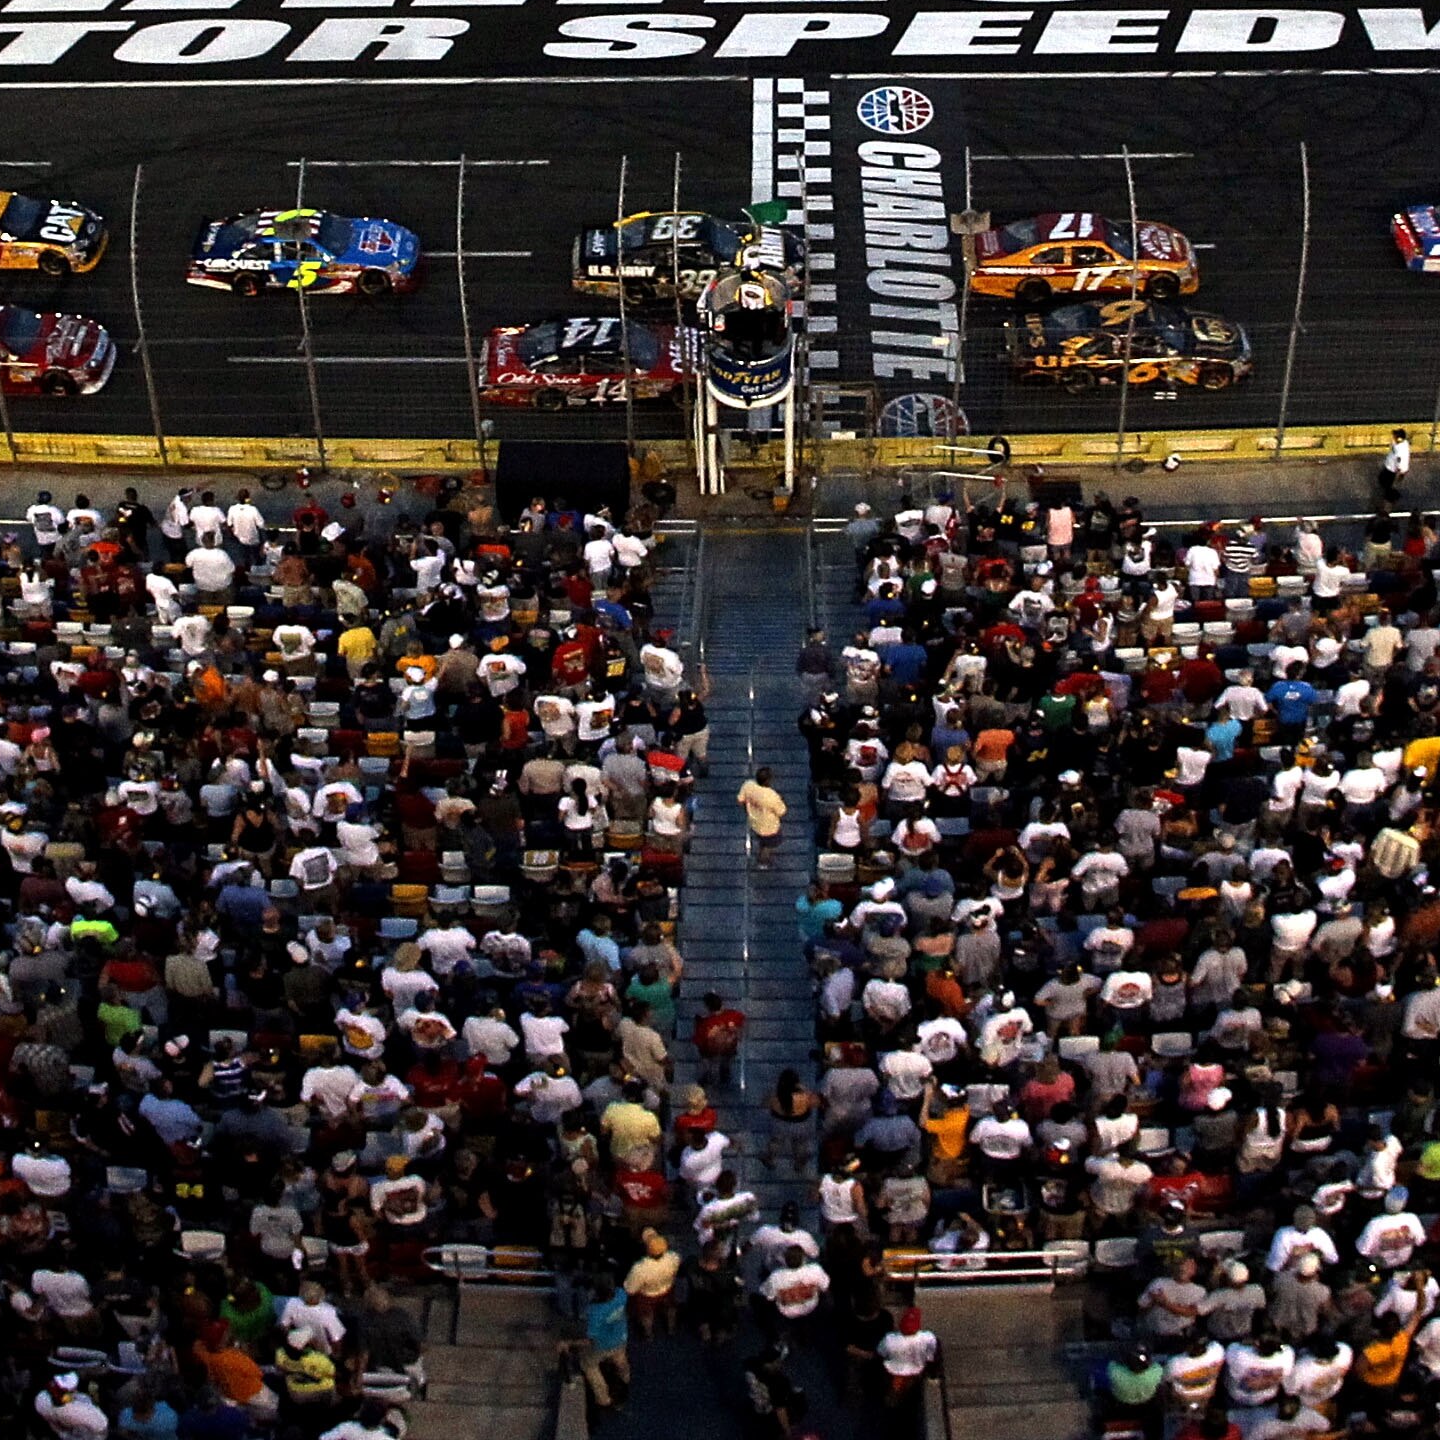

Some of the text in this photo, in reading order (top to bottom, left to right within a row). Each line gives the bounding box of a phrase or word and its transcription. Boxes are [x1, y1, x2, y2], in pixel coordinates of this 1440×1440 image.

[40, 205, 85, 244] CAT
[1049, 212, 1094, 240] 17
[203, 258, 272, 271] CARQUEST
[588, 265, 614, 277] U.S.
[857, 139, 966, 385] CHARLOTTE
[286, 261, 323, 288] 5
[679, 269, 718, 293] 39
[1073, 267, 1111, 291] 17
[1100, 299, 1148, 326] 6
[562, 317, 621, 348] 14
[497, 371, 582, 384] Old Spice
[740, 384, 760, 393] Get
[589, 378, 629, 402] 14
